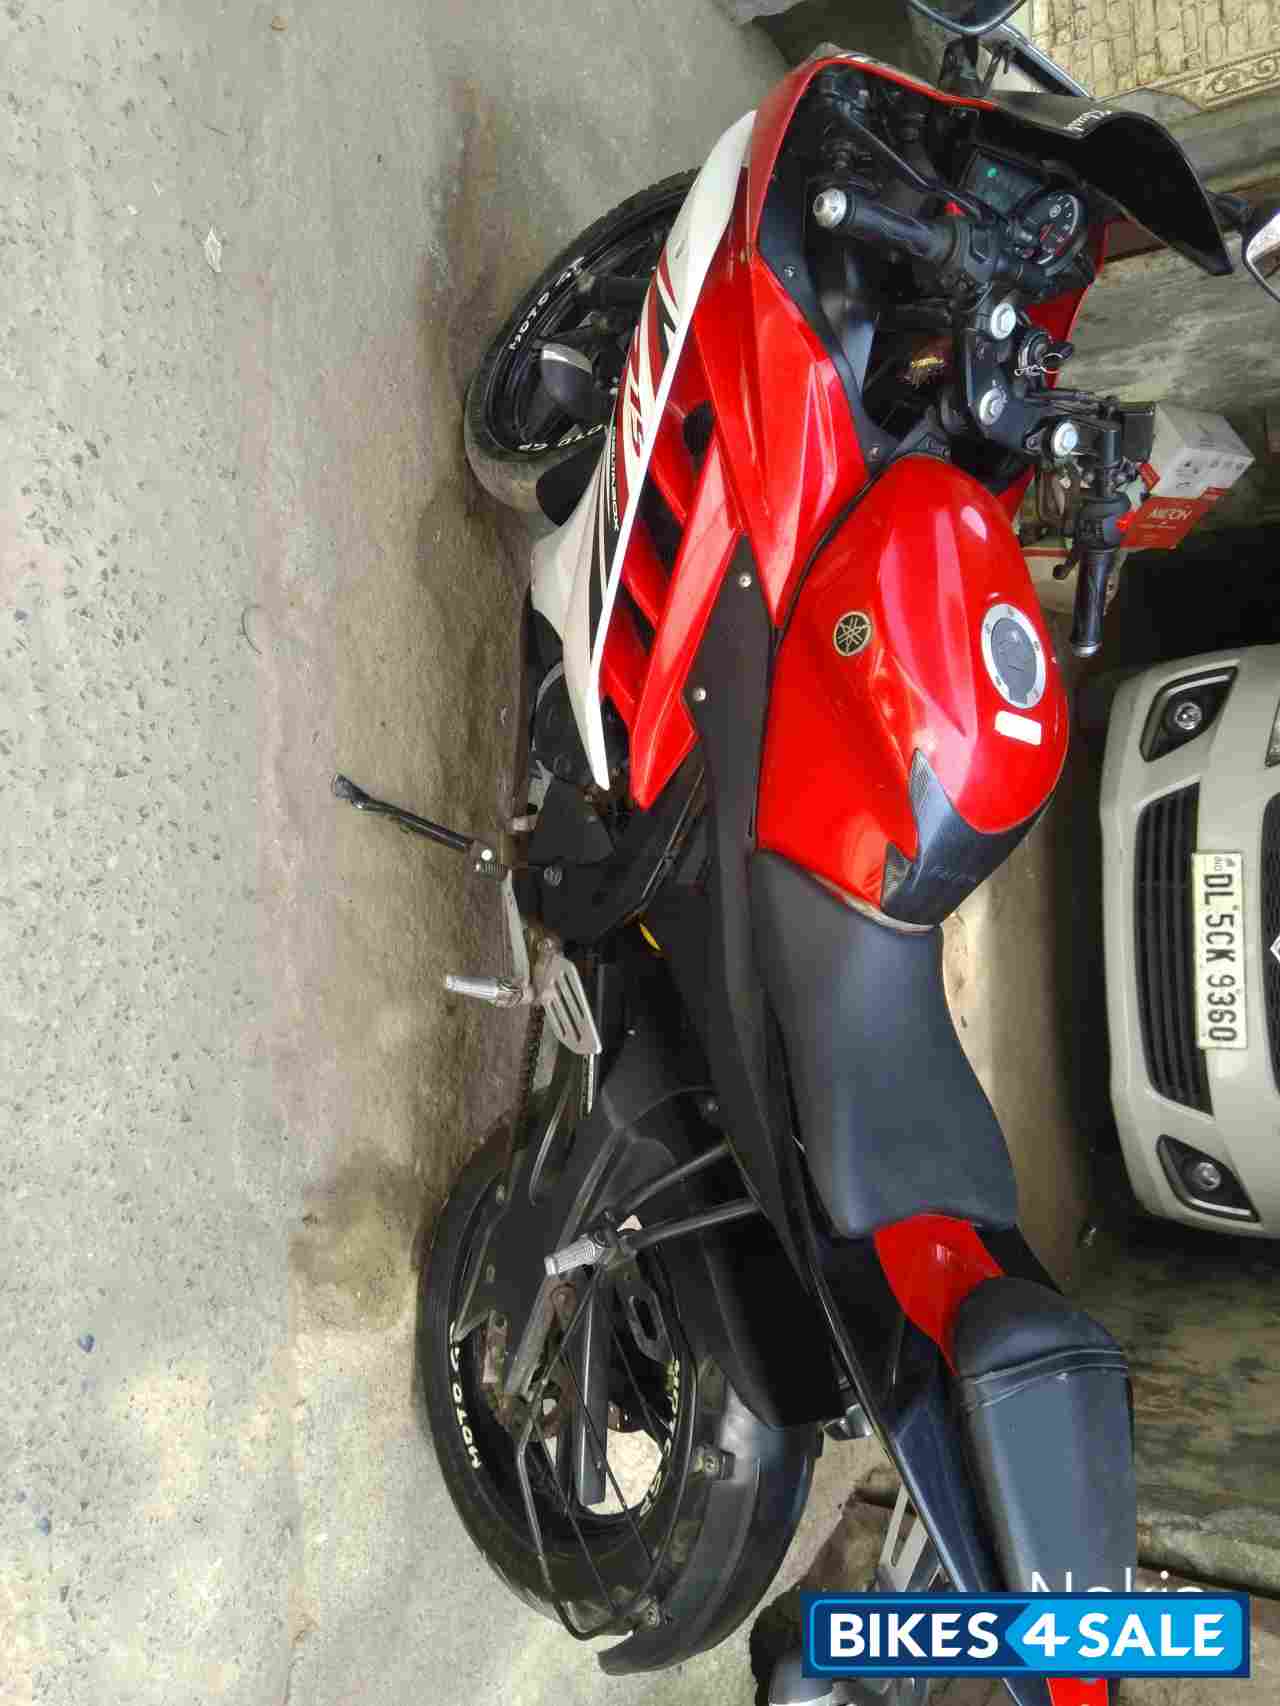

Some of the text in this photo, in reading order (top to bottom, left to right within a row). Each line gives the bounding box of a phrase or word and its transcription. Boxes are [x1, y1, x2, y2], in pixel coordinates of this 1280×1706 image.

[1204, 874, 1237, 1041] DL 5CK 9360
[452, 1382, 482, 1469] MOTO
